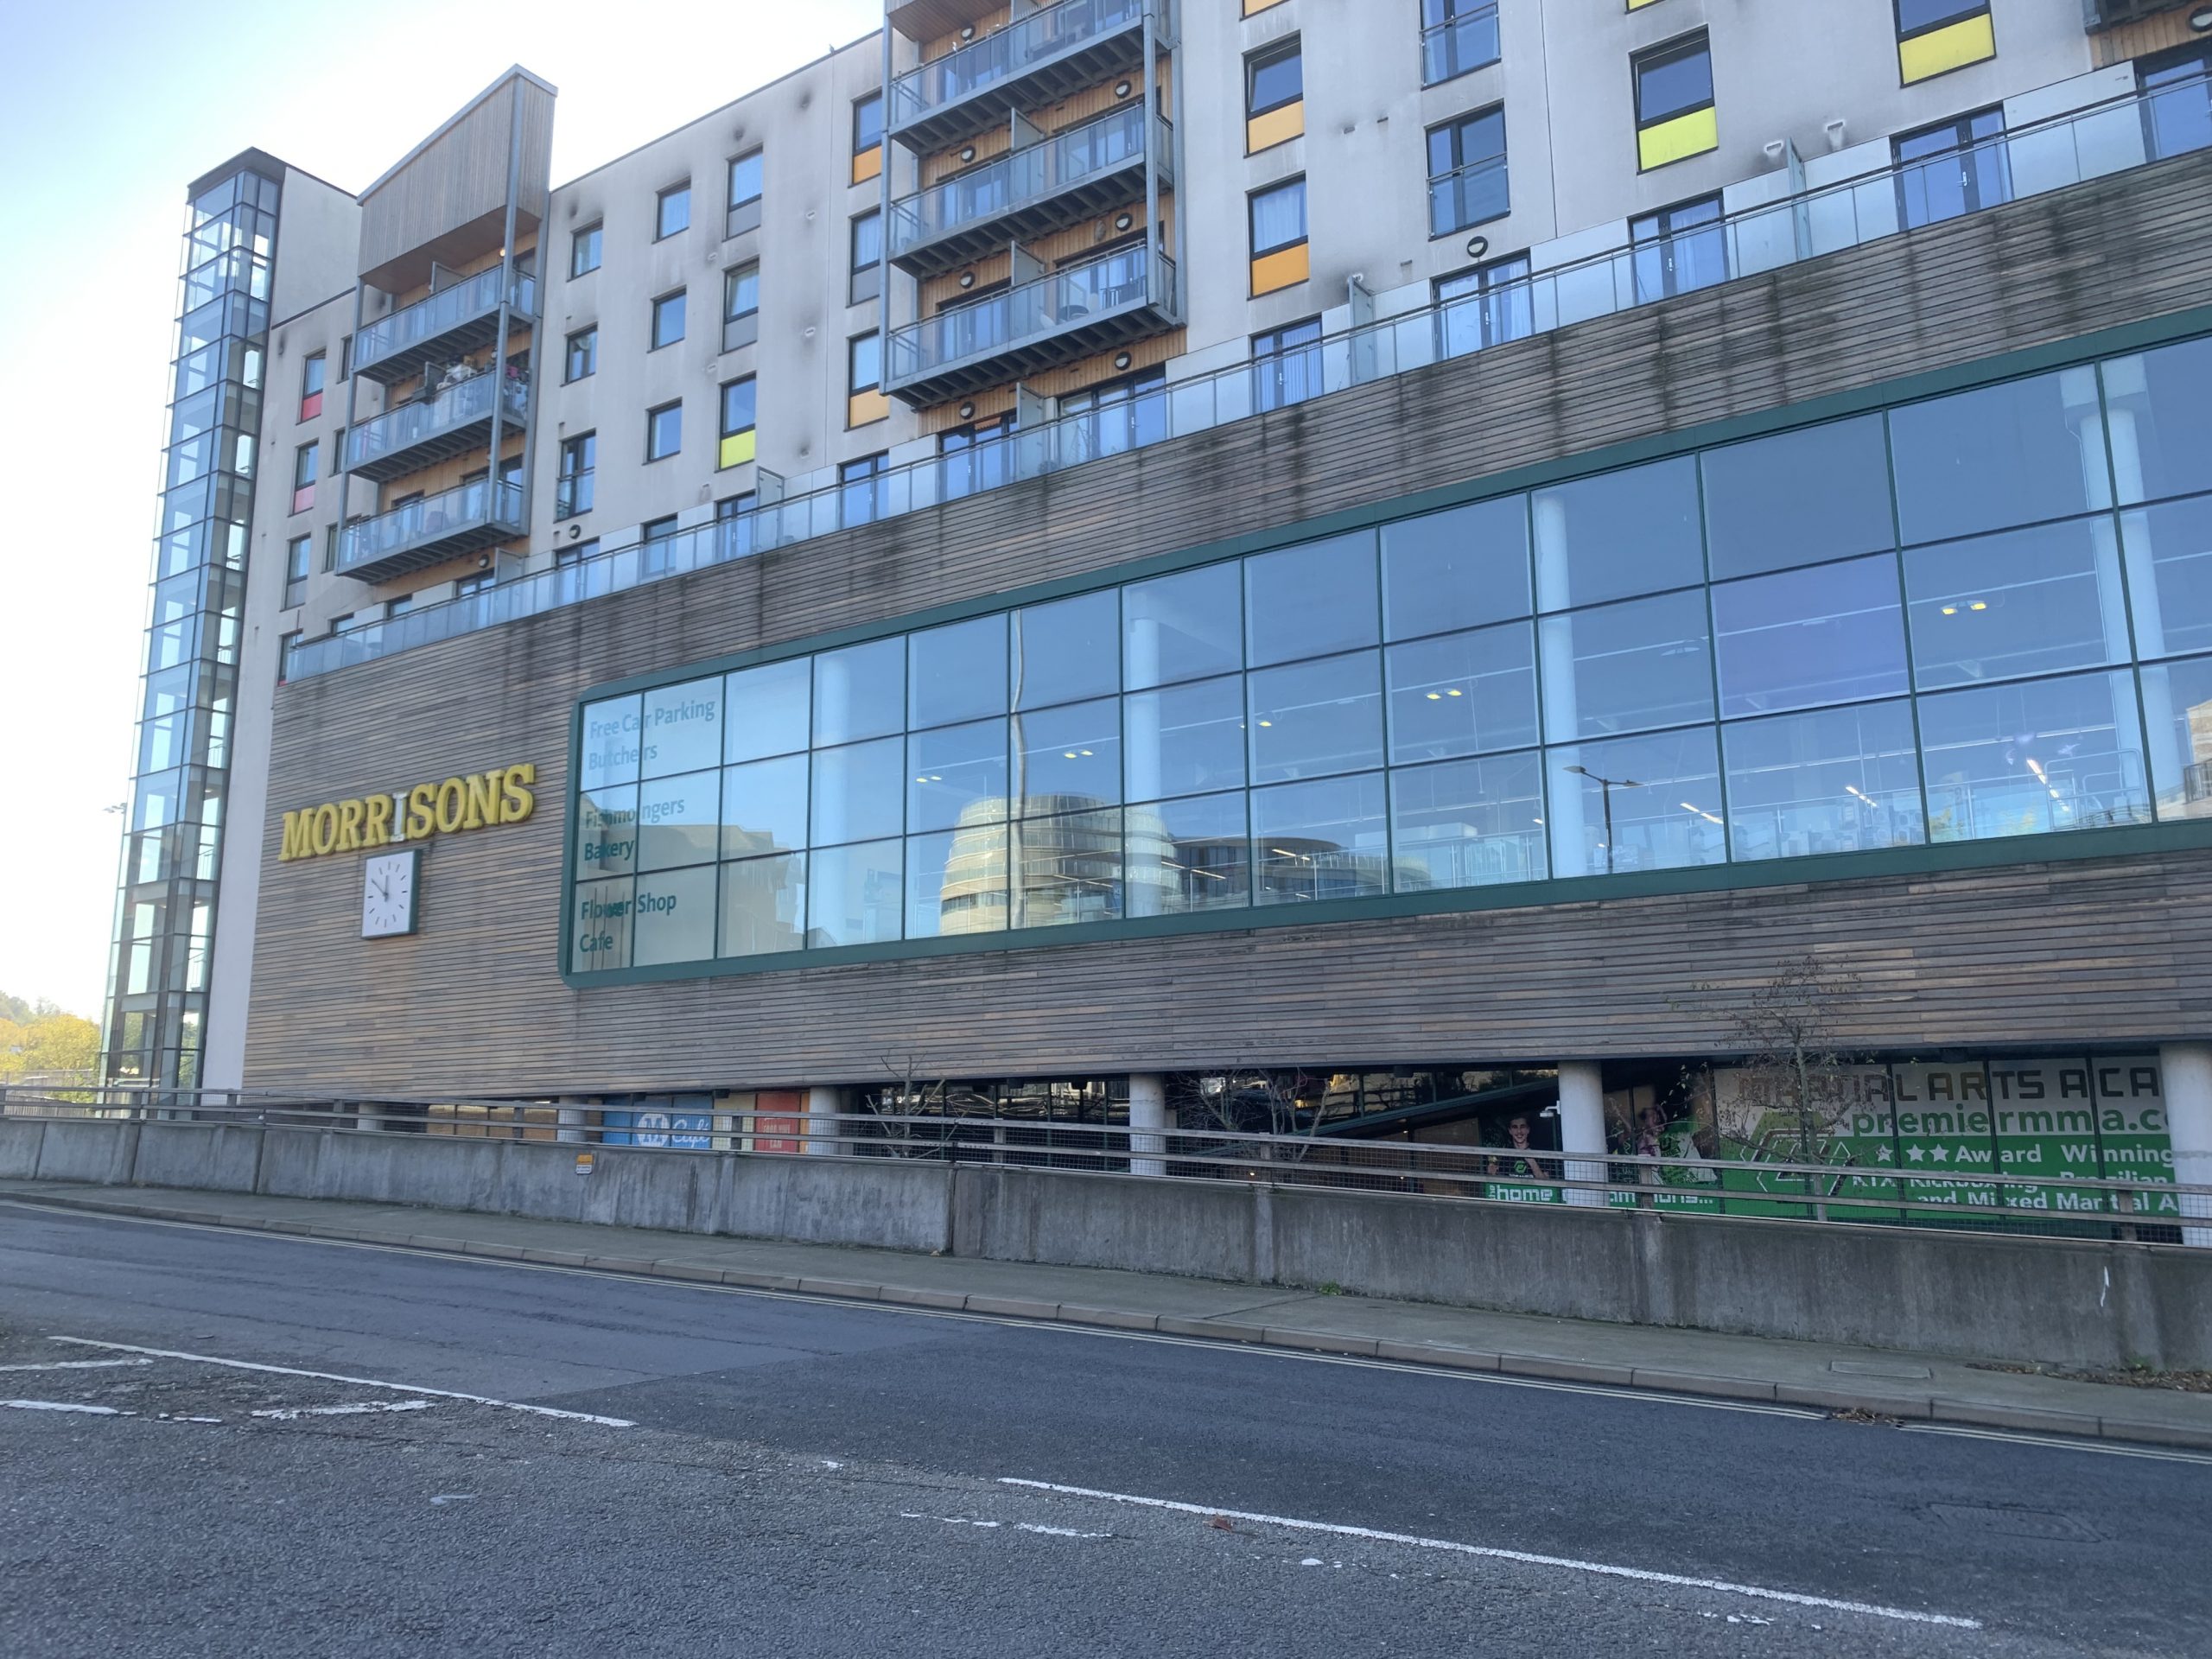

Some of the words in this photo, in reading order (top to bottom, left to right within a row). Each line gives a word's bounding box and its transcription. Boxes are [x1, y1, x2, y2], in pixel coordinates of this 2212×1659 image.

[590, 721, 620, 739] Free
[622, 714, 652, 733] Car
[654, 700, 715, 726] Parking
[588, 744, 658, 771] Butchers
[278, 764, 535, 861] MORRISONS
[586, 798, 685, 830] Fishmongers
[584, 839, 635, 861] Bakery
[581, 899, 632, 920] Flower
[638, 892, 677, 916] Shop
[579, 930, 613, 952] Cafe
[1928, 1070, 2045, 1102] ARTS
[1852, 1103, 2169, 1138] premiermma.c
[1955, 1143, 2043, 1163] Award
[2061, 1143, 2173, 1167] Winning
[1497, 1184, 1553, 1201] home
[1968, 1192, 2048, 1209] Mixed
[2056, 1192, 2150, 1211] Martal
